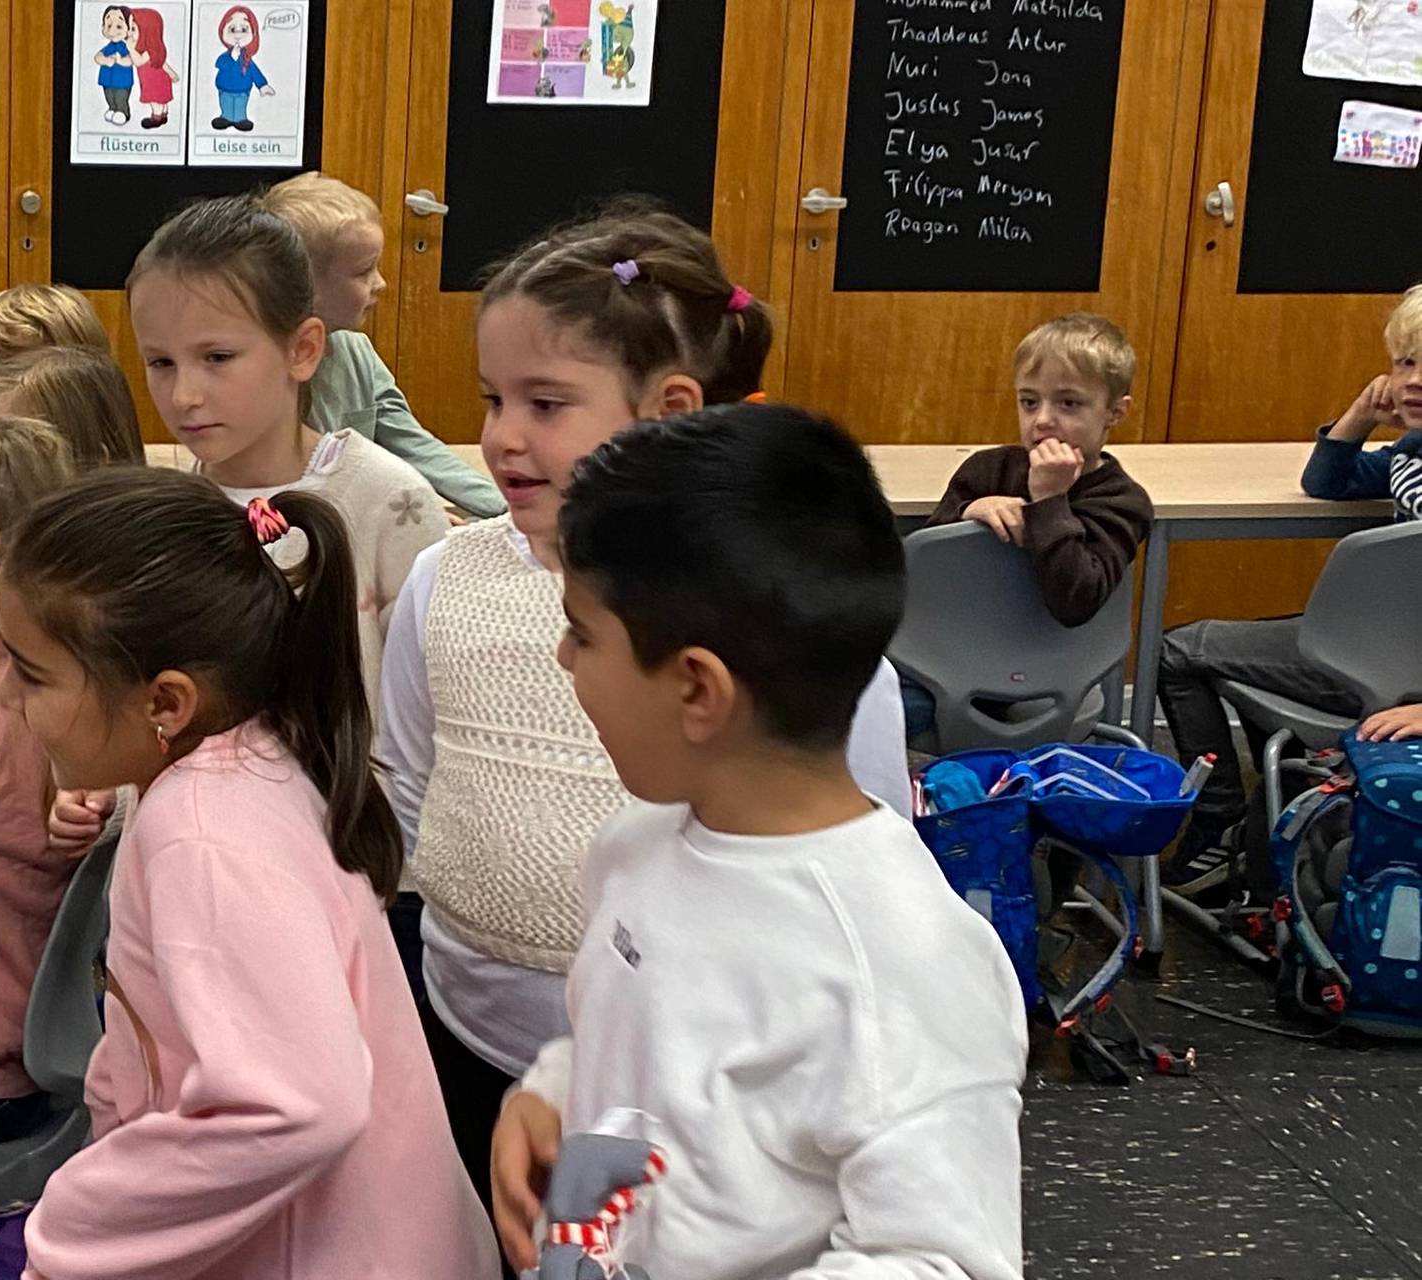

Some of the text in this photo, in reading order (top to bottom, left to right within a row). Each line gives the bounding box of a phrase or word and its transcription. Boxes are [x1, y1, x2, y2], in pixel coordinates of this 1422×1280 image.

[887, 51, 1031, 87] Nuri Jona
[980, 99, 1043, 131] James
[100, 136, 160, 152] flüstern
[213, 138, 281, 153] leise sein
[885, 129, 949, 163] Elya
[884, 169, 964, 208] Filippa
[979, 215, 1032, 243] Milan
